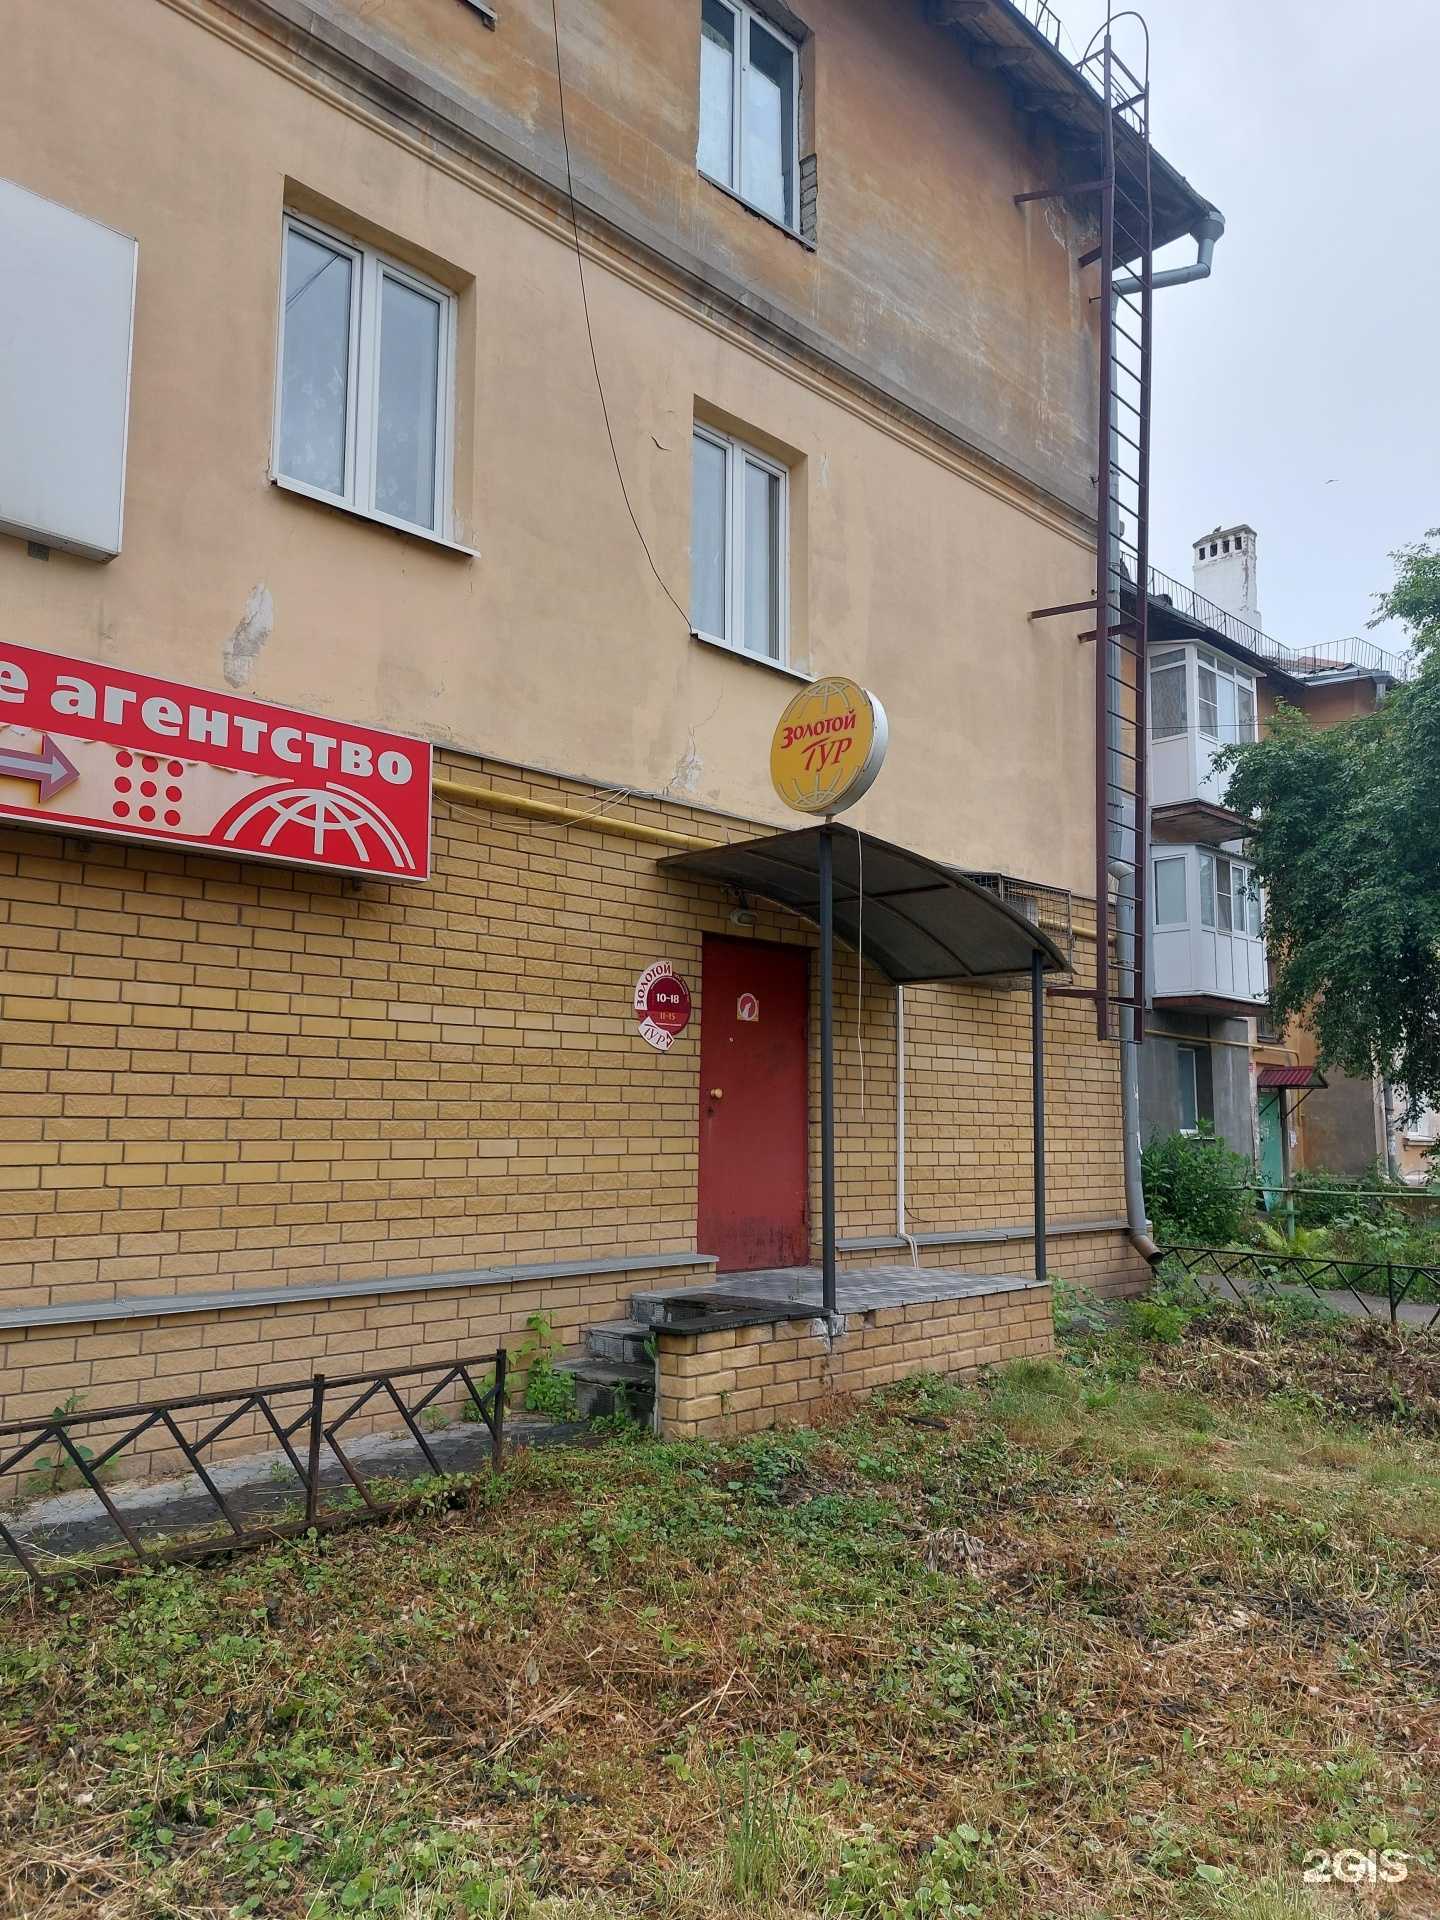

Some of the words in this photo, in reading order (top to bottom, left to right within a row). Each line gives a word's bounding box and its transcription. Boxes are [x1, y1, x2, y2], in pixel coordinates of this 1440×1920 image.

[50, 675, 413, 785] агентство
[781, 709, 857, 749] ЗОЛОТОЙ
[800, 736, 853, 772] ТУР
[636, 962, 671, 1007] ЗОЛОТОЙ
[656, 993, 680, 1004] 10-18
